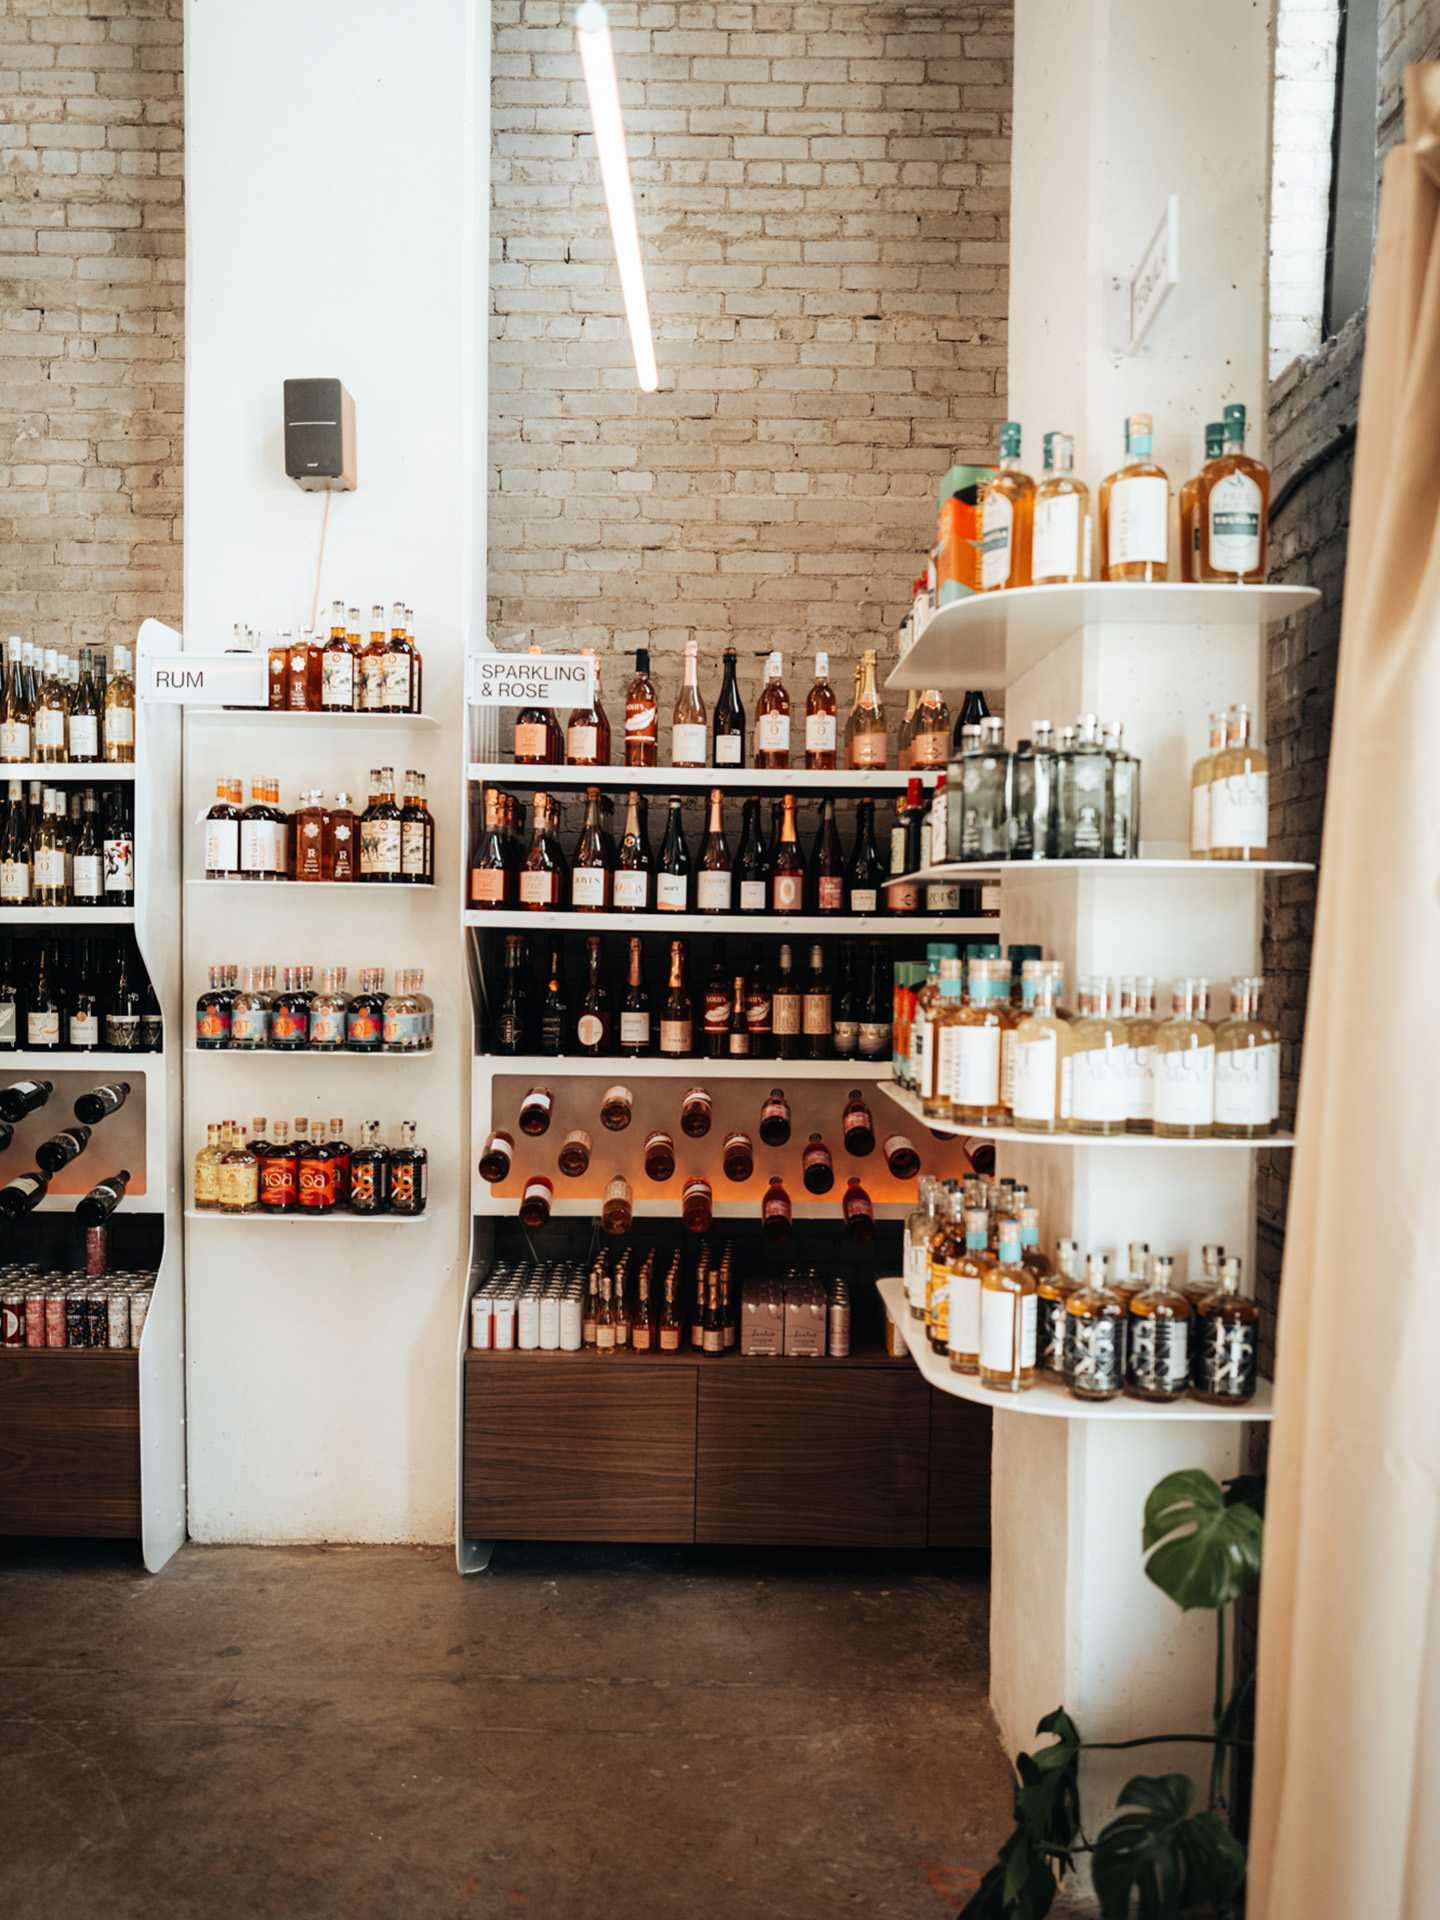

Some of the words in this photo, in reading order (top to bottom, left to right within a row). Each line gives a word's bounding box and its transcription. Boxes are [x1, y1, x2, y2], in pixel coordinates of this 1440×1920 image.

[156, 671, 203, 688] RUM
[481, 664, 586, 681] SPARKLING
[481, 682, 492, 696] &
[499, 683, 549, 698] ROSE
